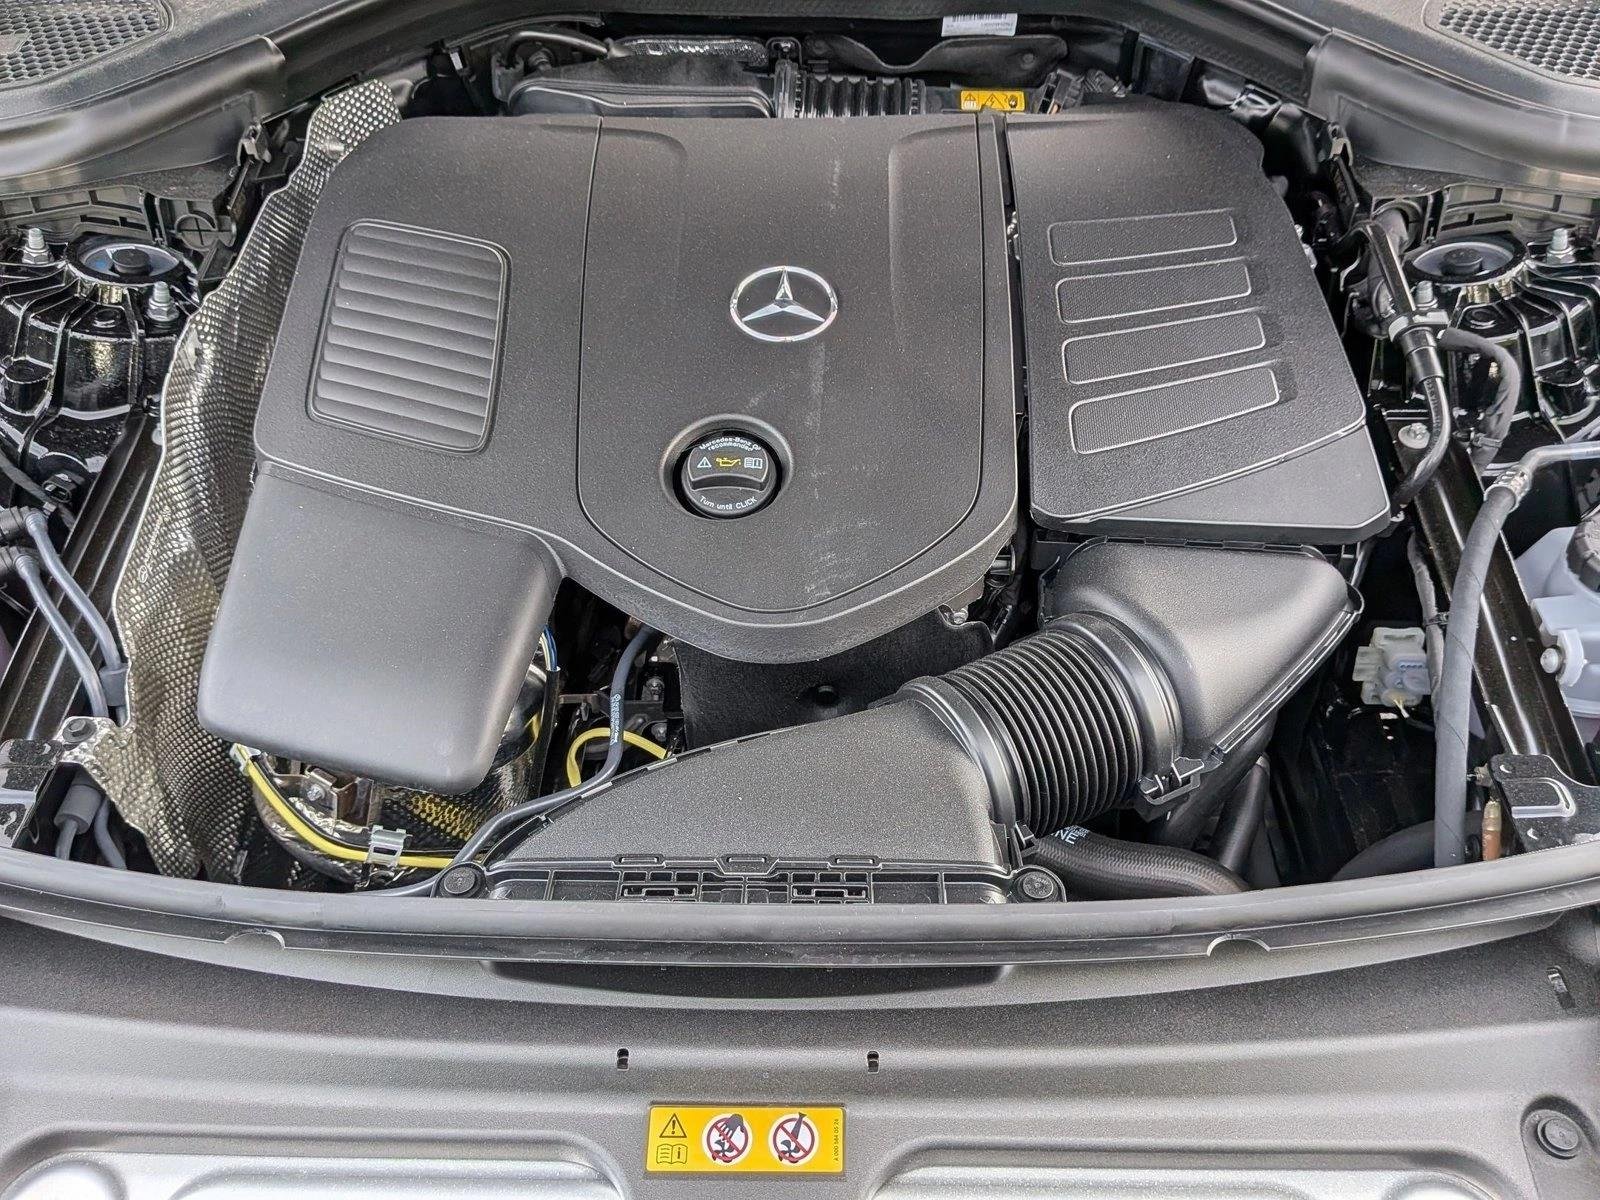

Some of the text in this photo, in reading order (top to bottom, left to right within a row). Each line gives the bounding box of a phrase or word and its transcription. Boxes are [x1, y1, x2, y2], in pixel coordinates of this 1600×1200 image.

[700, 495, 715, 508] Turn
[735, 496, 758, 509] CLICK
[1051, 829, 1078, 844] NE
